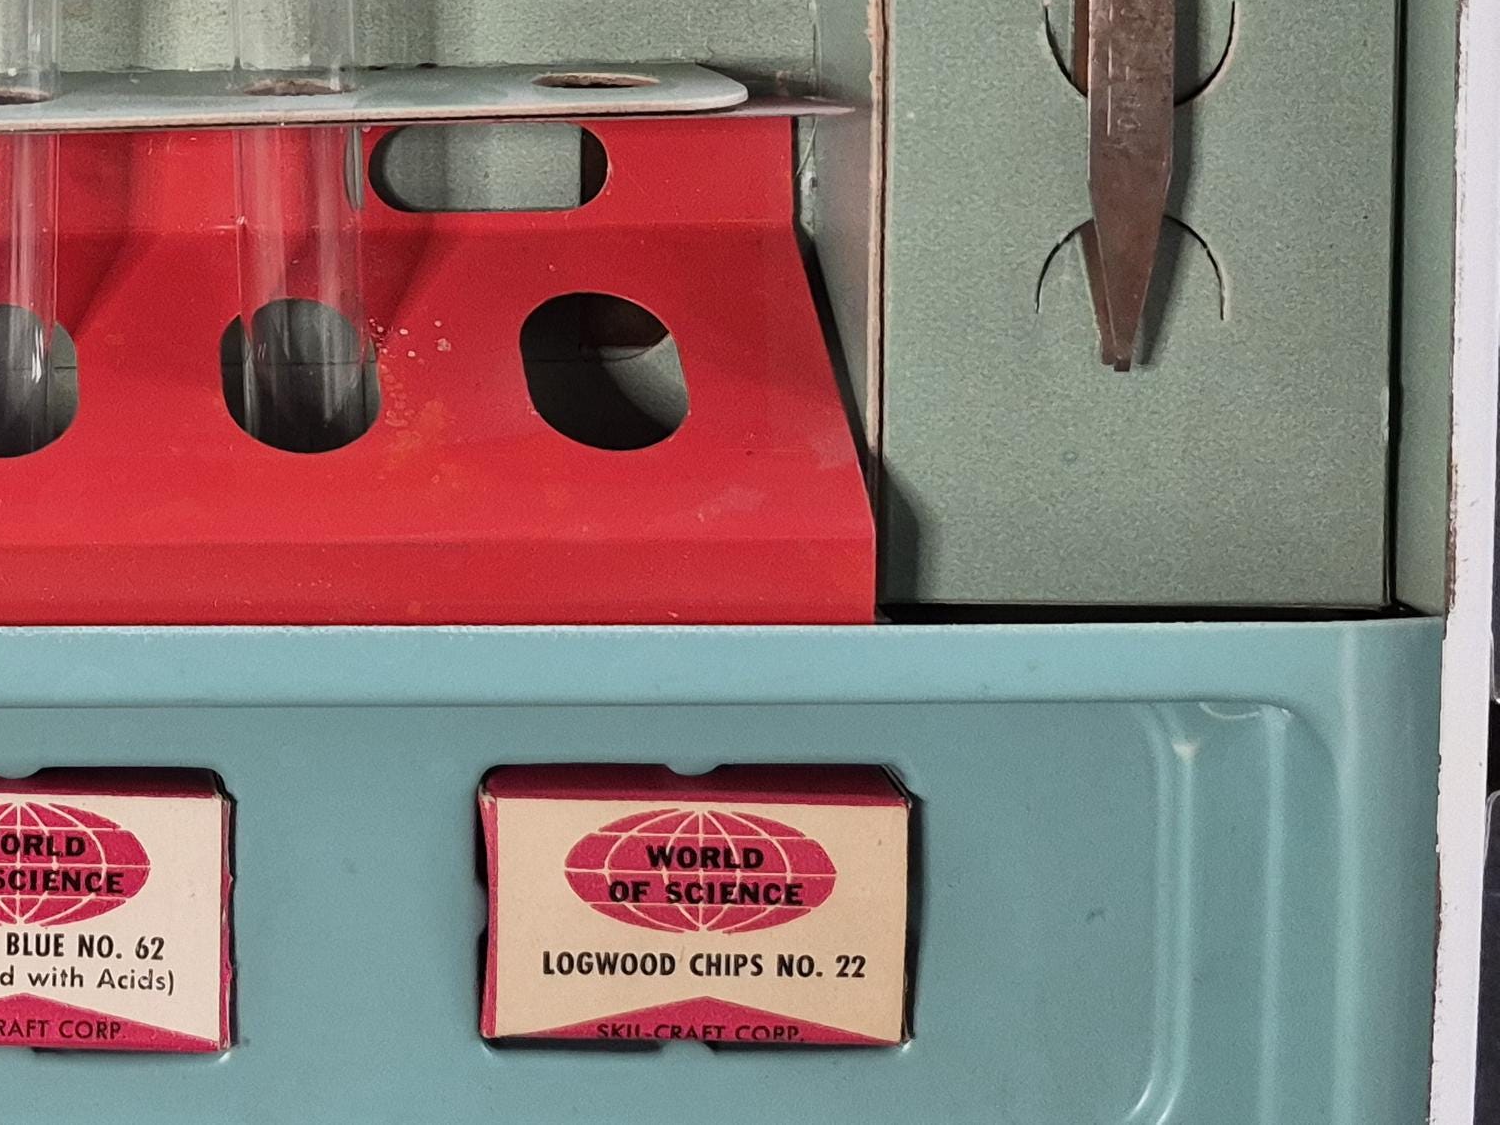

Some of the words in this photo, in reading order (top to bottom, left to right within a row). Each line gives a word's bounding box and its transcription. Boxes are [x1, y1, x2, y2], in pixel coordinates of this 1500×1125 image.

[646, 845, 764, 870] WORLD
[609, 880, 650, 903] OF
[665, 880, 803, 906] SCIENCE
[6, 932, 65, 958] BLUE
[77, 934, 122, 960] NO.
[135, 936, 165, 960] 62
[542, 950, 676, 976] LOGWOOD
[689, 952, 764, 977] CHIPS
[777, 954, 823, 978] NO.
[836, 954, 867, 979] 22
[27, 966, 84, 988] with
[96, 967, 175, 996] Acids)
[735, 1024, 805, 1042] CORP.
